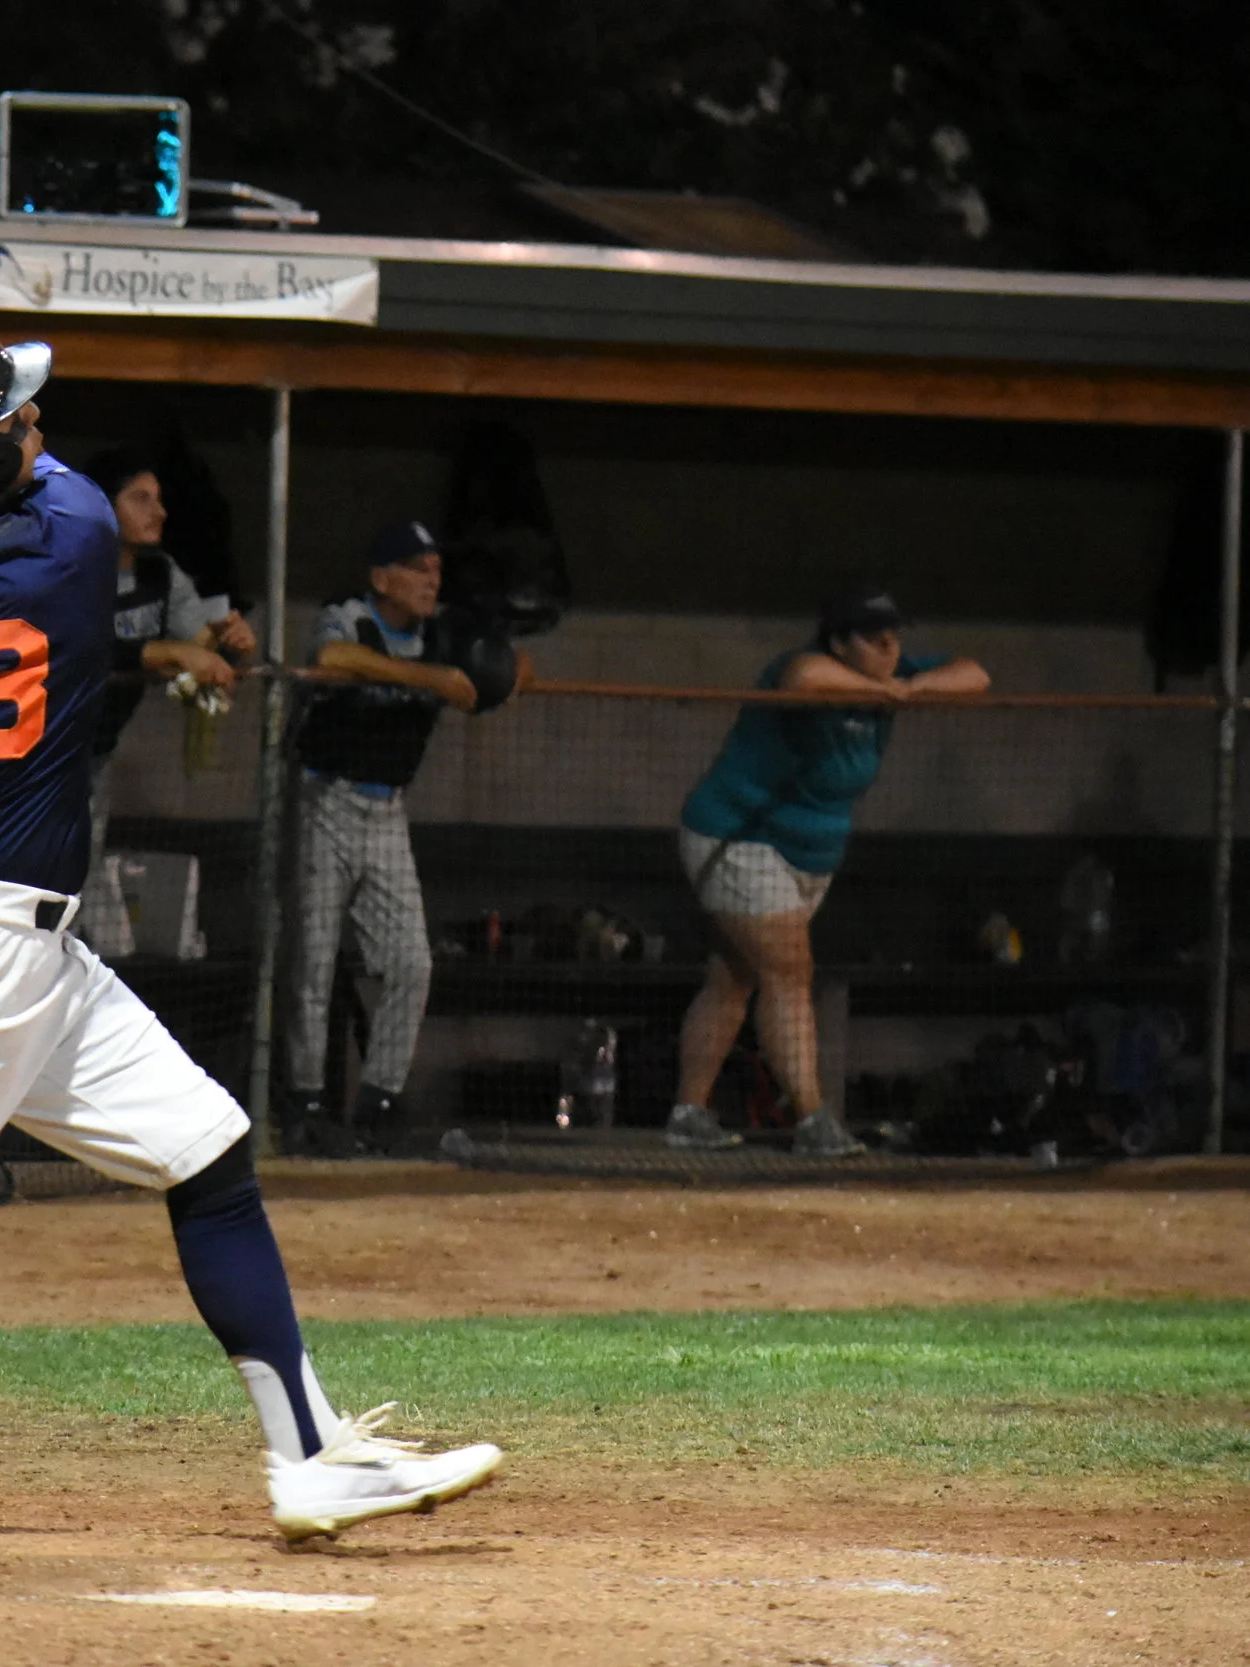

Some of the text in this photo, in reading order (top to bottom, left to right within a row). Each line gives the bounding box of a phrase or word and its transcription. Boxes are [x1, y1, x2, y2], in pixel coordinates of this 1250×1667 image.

[62, 251, 336, 311] Hospice by the Bay
